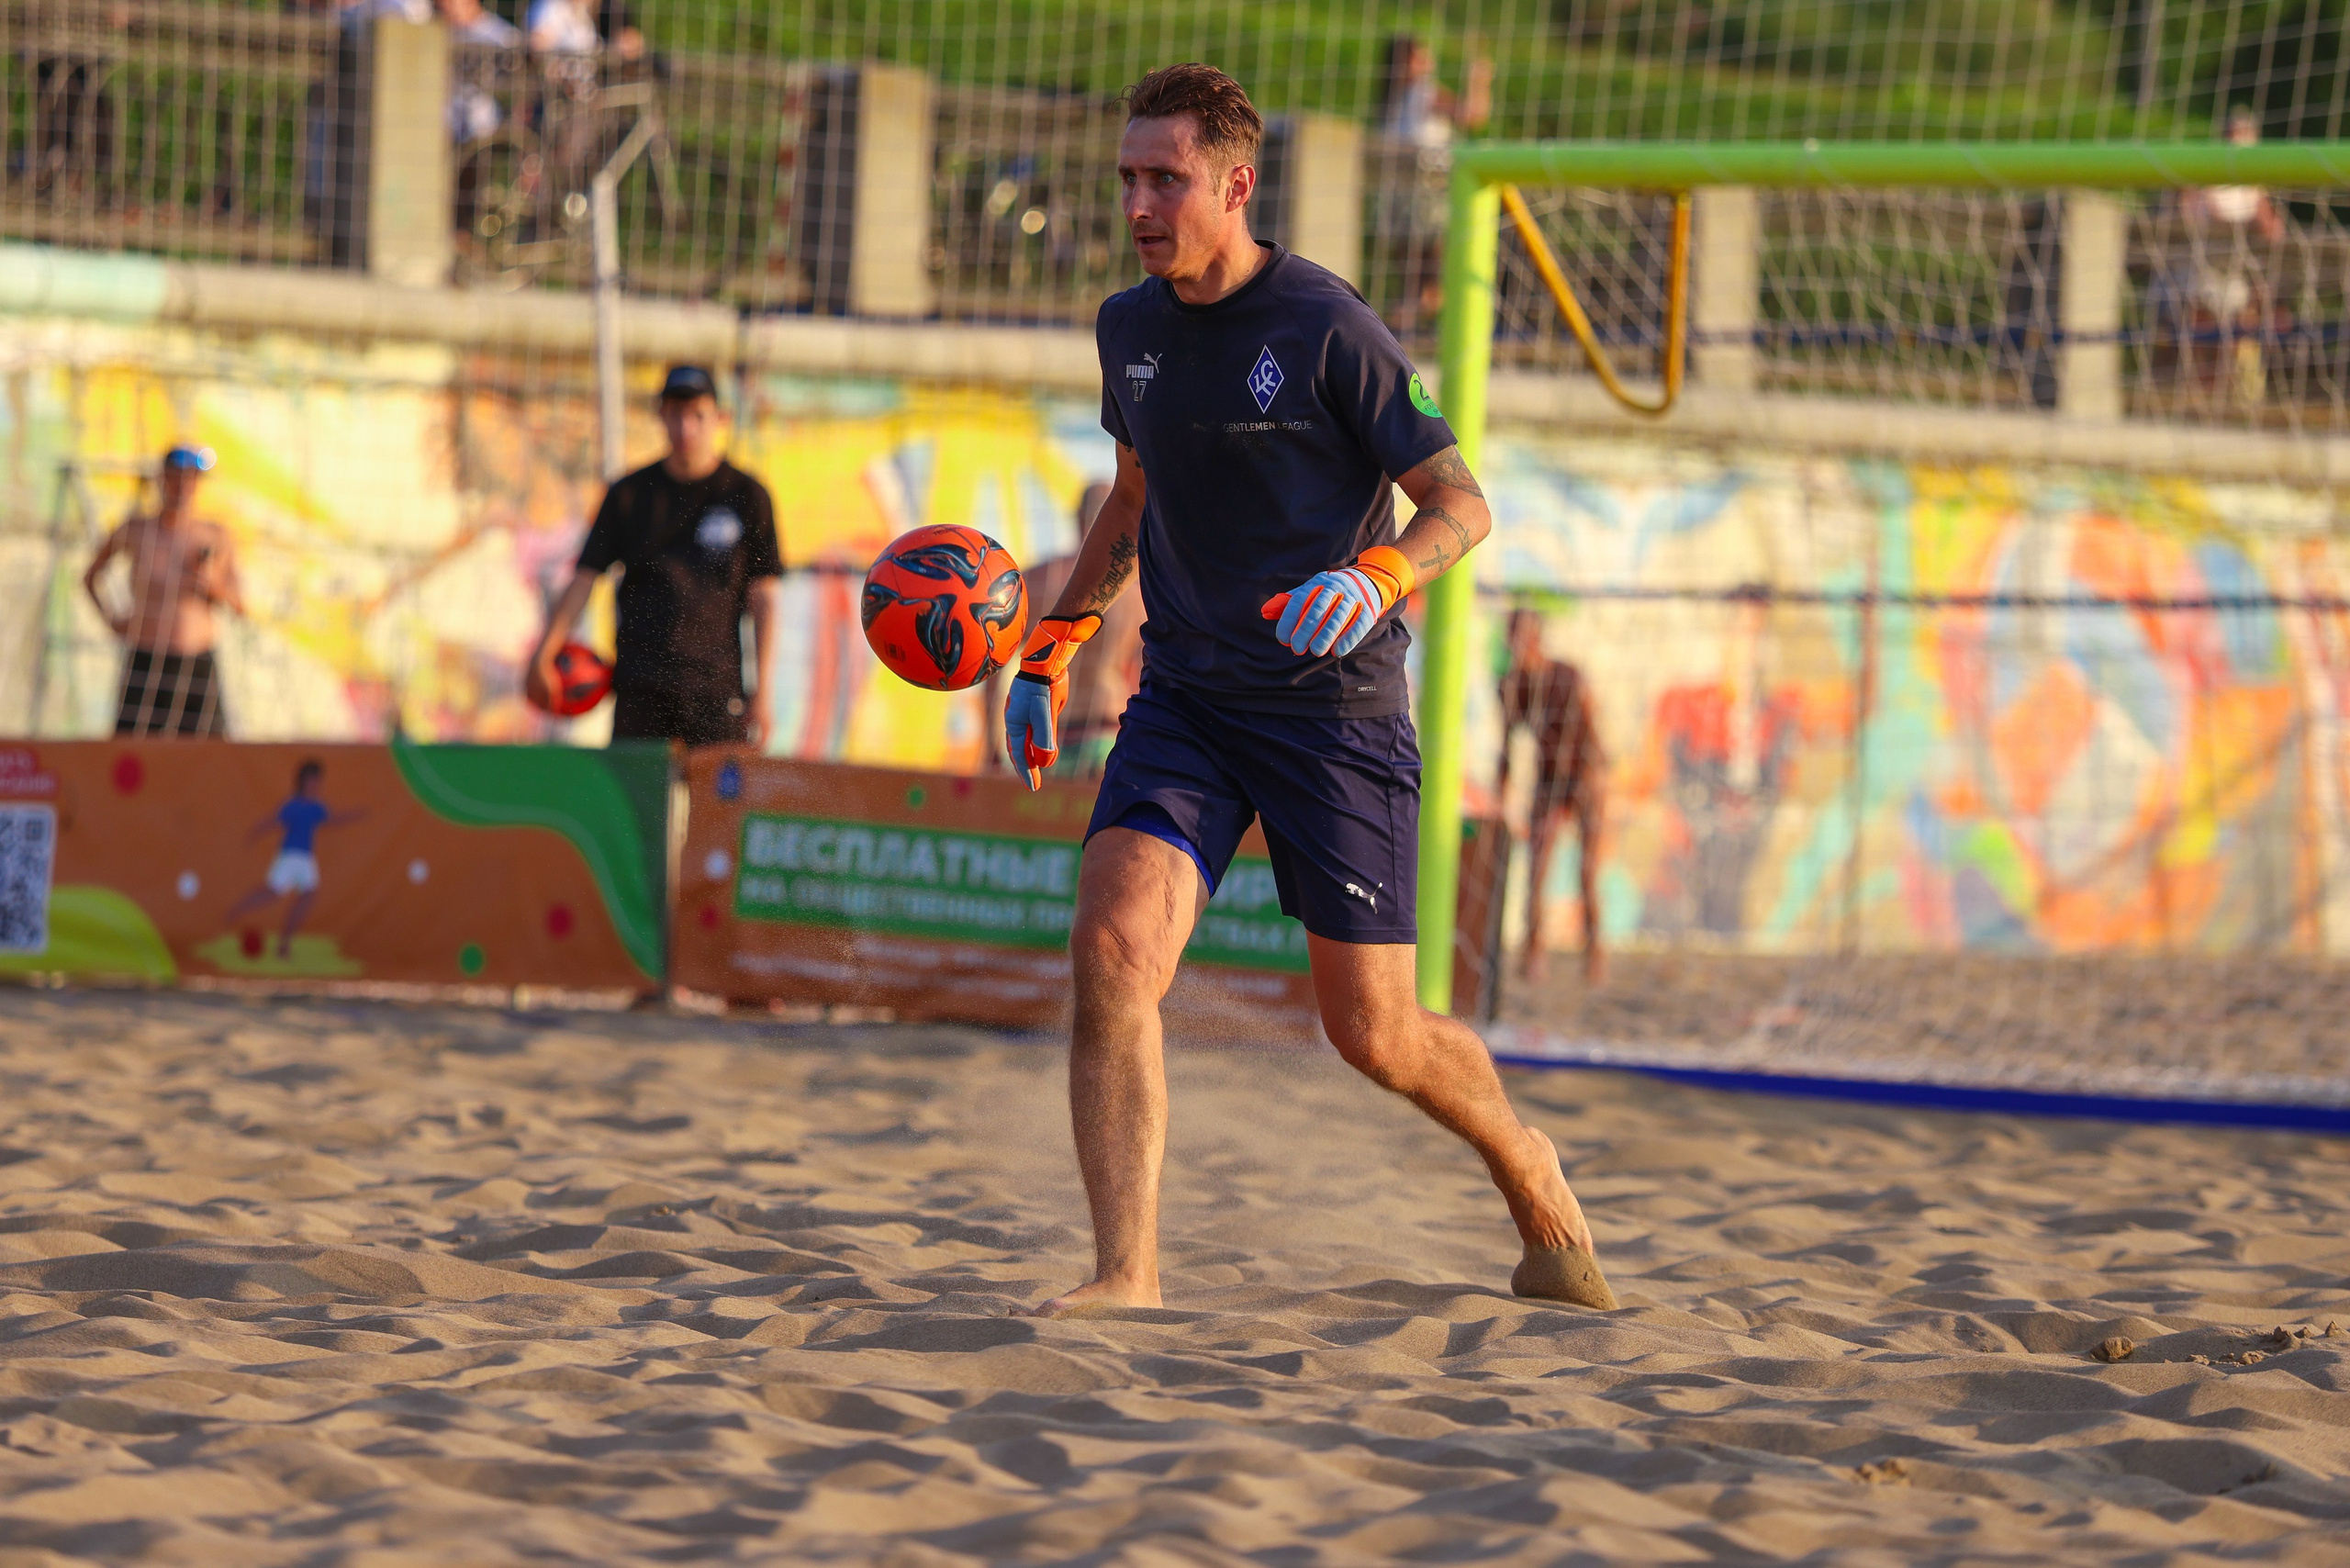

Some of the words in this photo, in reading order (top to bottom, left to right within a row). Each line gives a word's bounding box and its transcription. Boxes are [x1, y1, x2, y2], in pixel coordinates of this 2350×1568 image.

[1125, 364, 1155, 379] PUMA
[1132, 380, 1147, 402] 27
[1223, 421, 1276, 433] GENTLEMEN
[746, 821, 1074, 896] БЕСПЛАТНЫЕ
